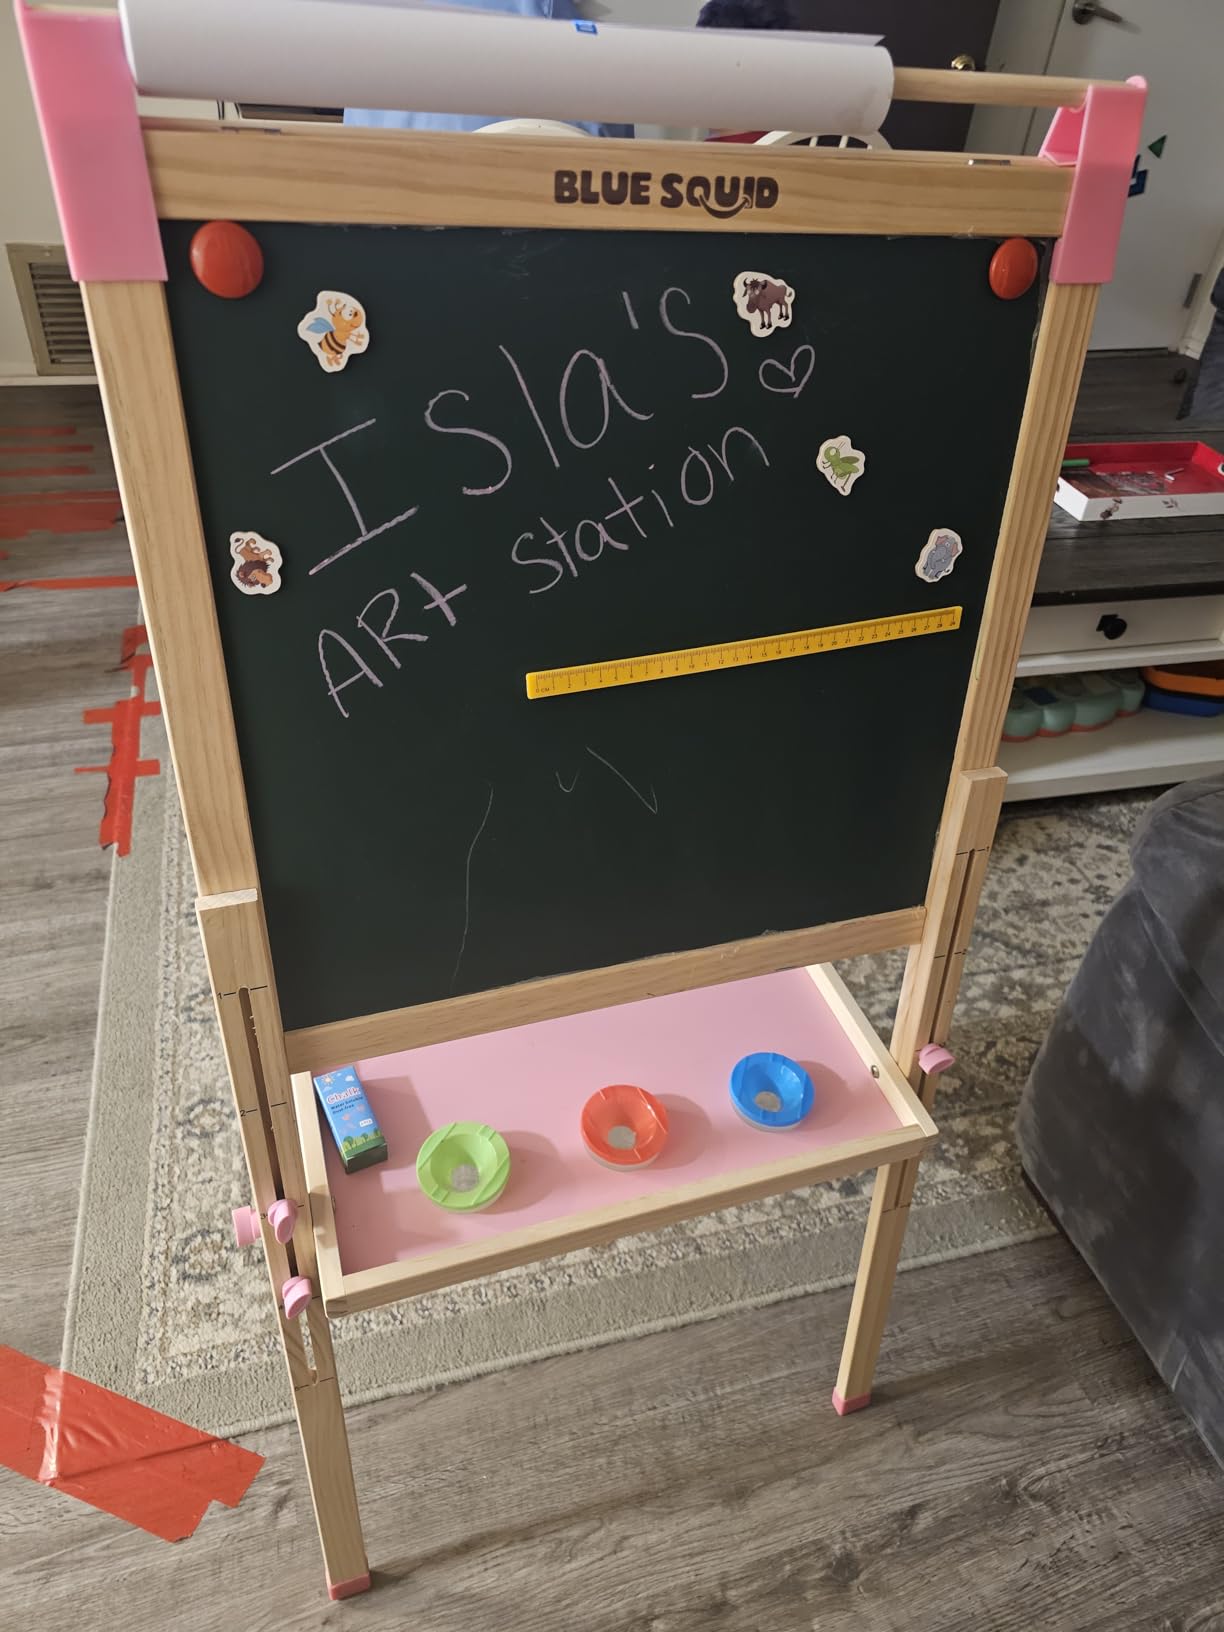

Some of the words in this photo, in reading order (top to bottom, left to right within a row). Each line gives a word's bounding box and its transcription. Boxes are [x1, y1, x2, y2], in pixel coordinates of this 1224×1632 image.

[554, 170, 652, 205] BLUE
[660, 173, 779, 219] SQUID
[327, 1087, 361, 1104] Chalk
